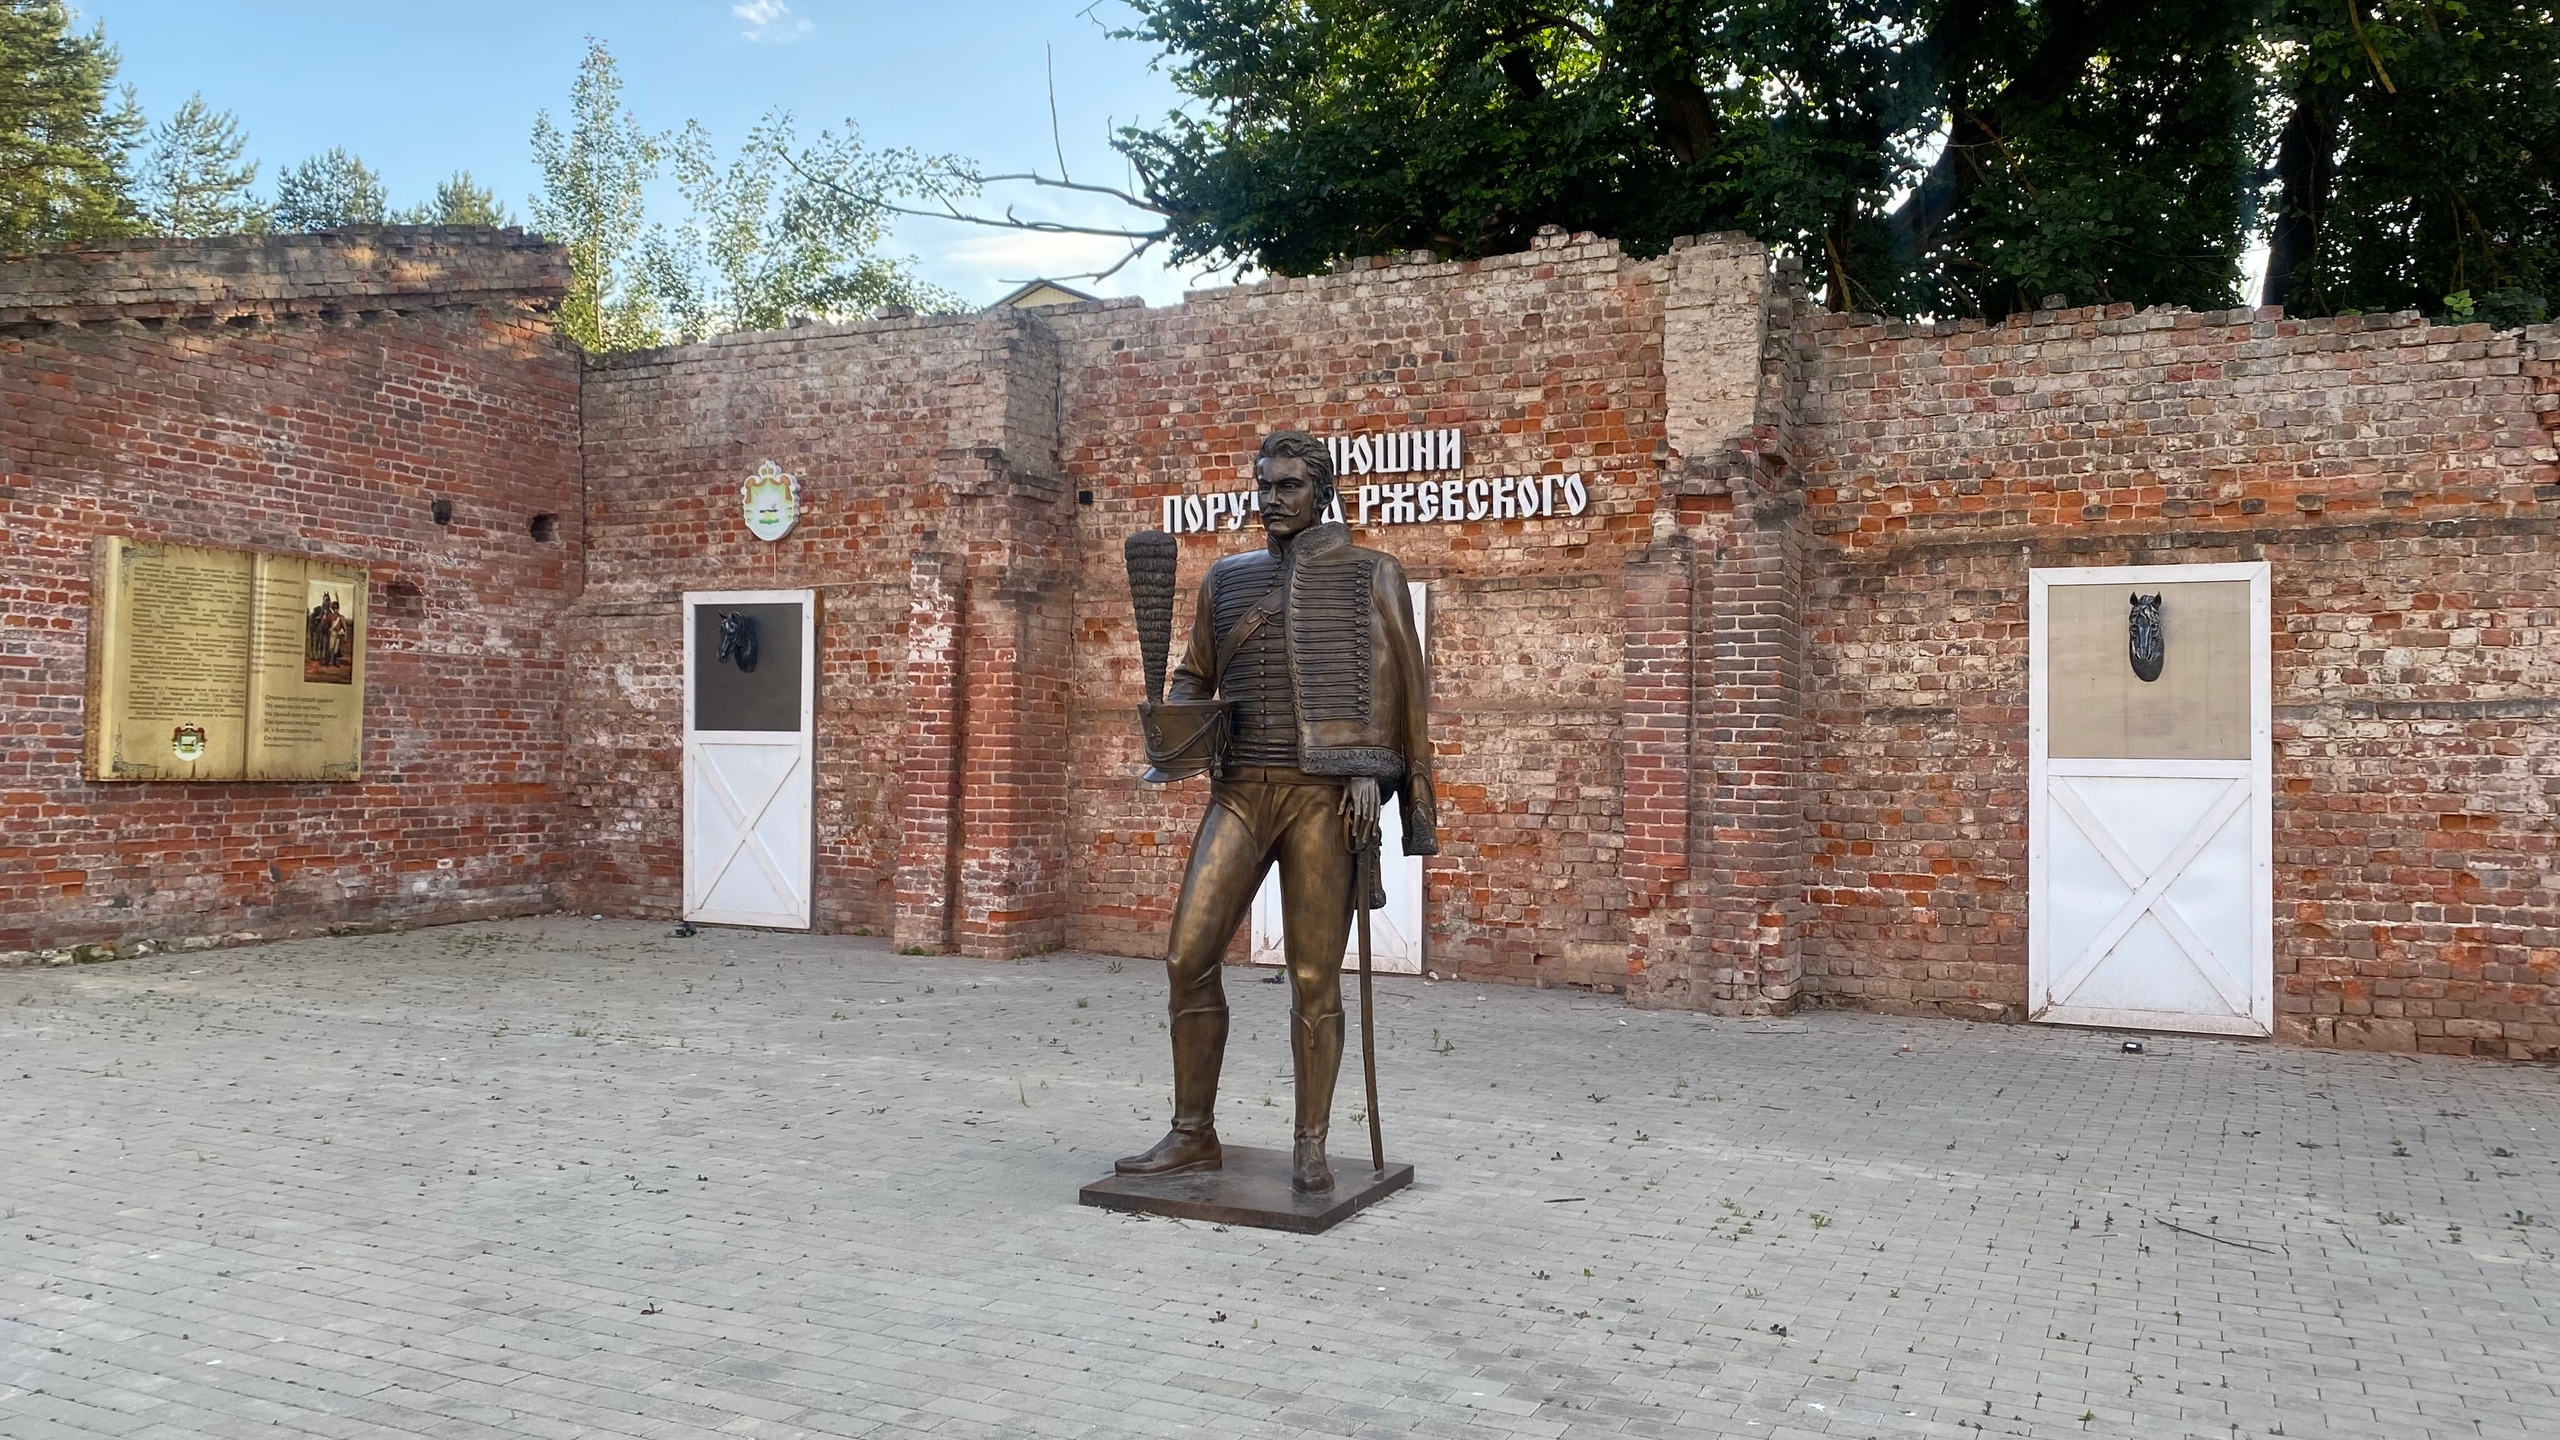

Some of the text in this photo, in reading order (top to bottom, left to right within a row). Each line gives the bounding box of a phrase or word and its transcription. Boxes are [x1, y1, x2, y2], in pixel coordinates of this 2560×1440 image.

[1317, 428, 1461, 476] ЮШНИ
[1163, 472, 1588, 534] ПОРУА РЖЕВСКОГО
